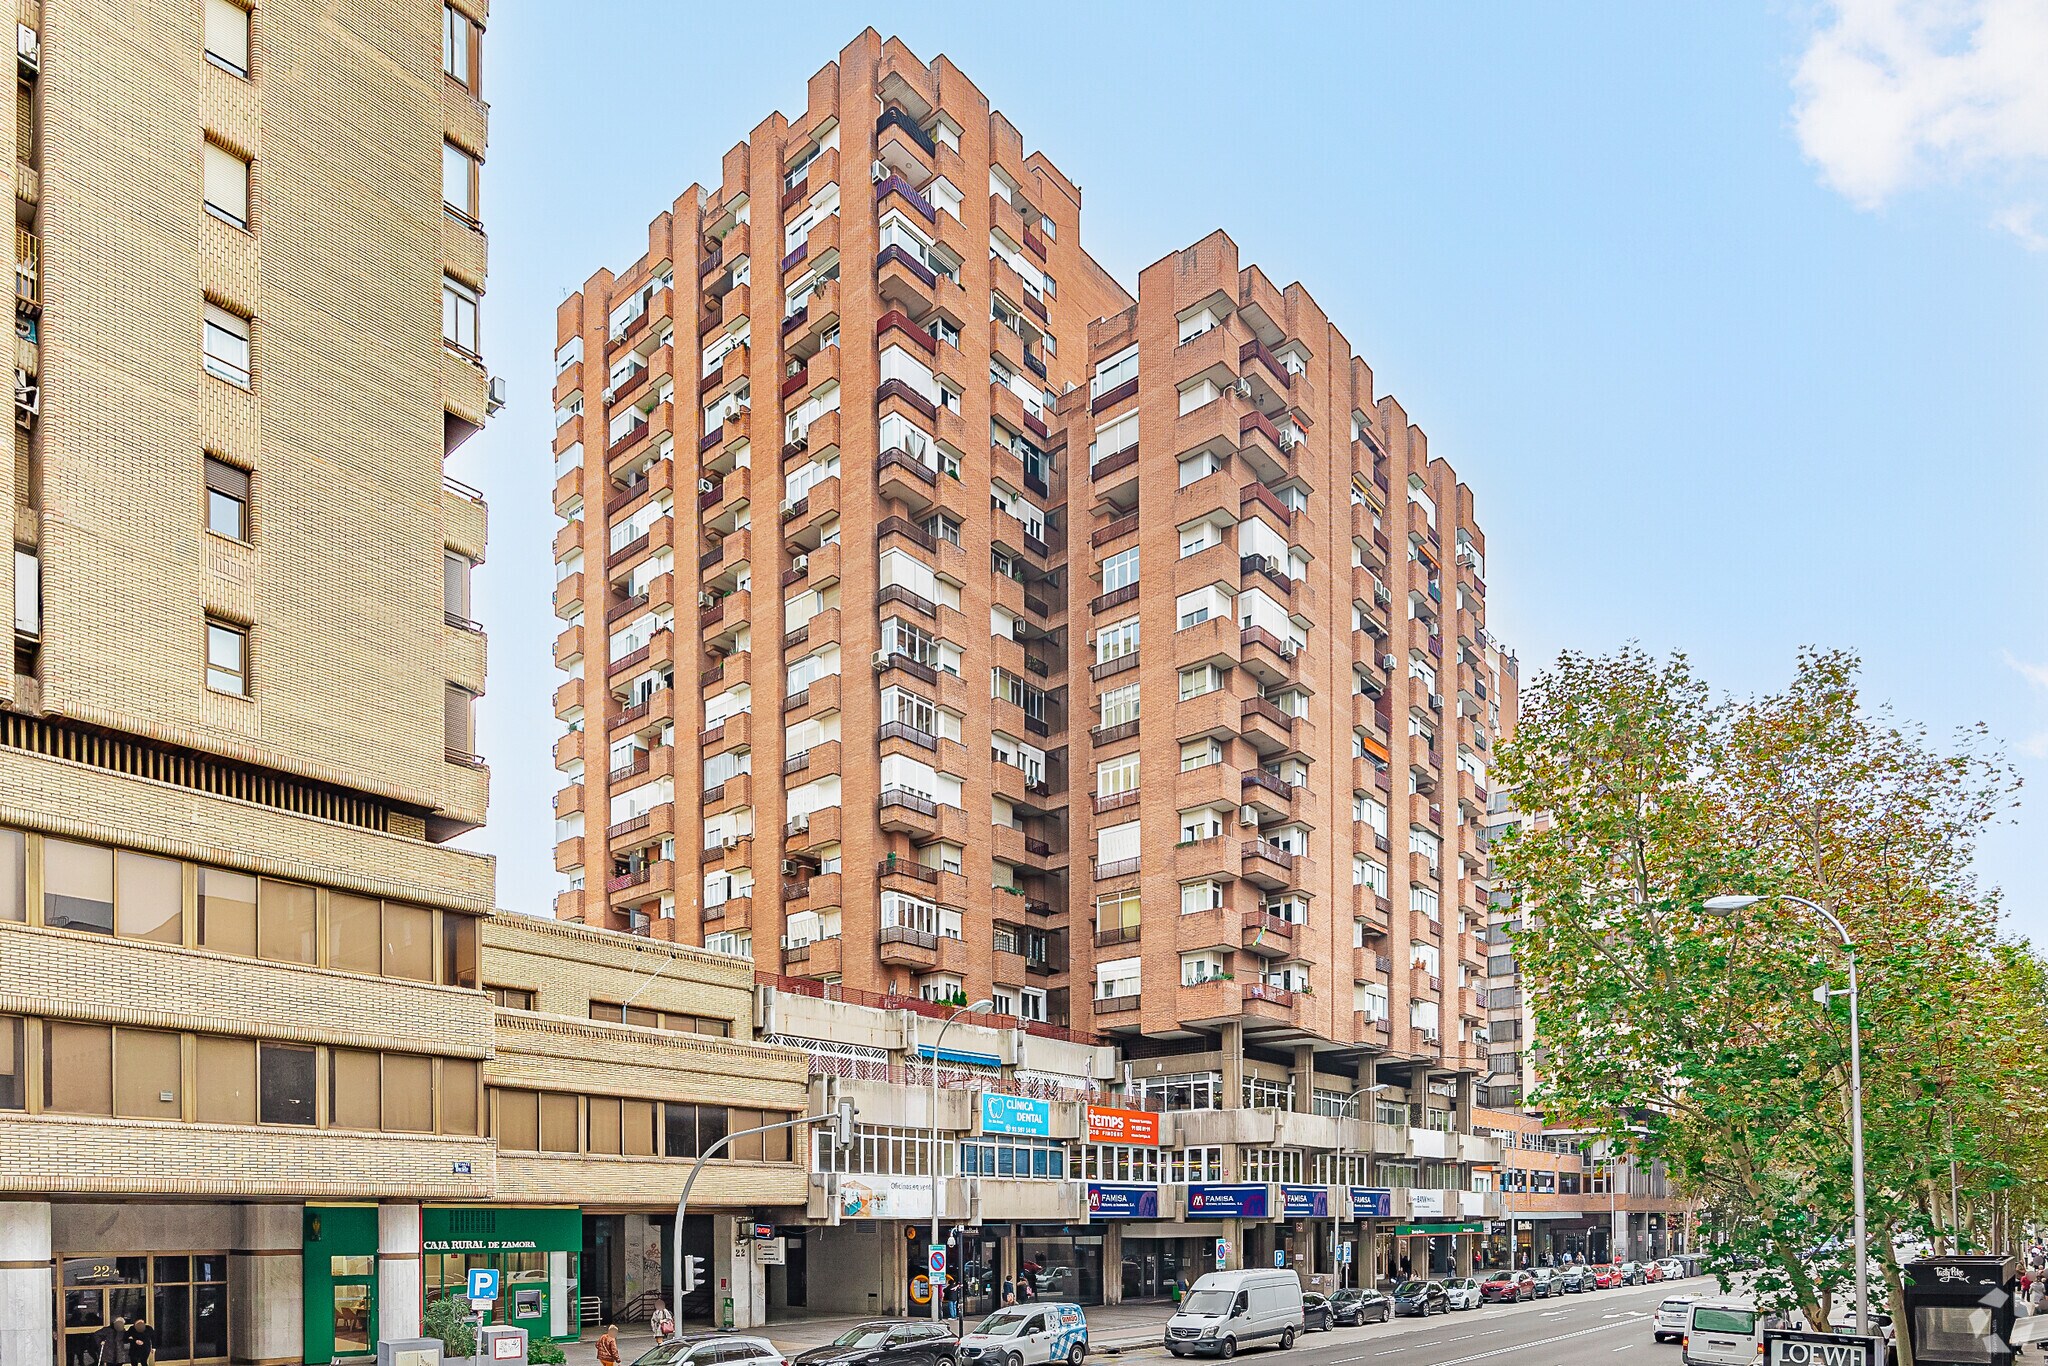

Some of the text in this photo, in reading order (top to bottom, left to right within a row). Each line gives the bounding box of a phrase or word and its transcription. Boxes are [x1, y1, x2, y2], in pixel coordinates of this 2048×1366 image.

[1006, 1098, 1033, 1111] CLÍNICA
[1017, 1112, 1043, 1123] DENTAL
[1101, 1194, 1127, 1203] FAMISA
[1287, 1194, 1308, 1203] FAMISA
[1354, 1196, 1371, 1204] FAMISA
[423, 1240, 450, 1250] CAJA
[451, 1240, 486, 1250] RURAL
[488, 1241, 500, 1249] DE
[735, 1249, 746, 1257] 22
